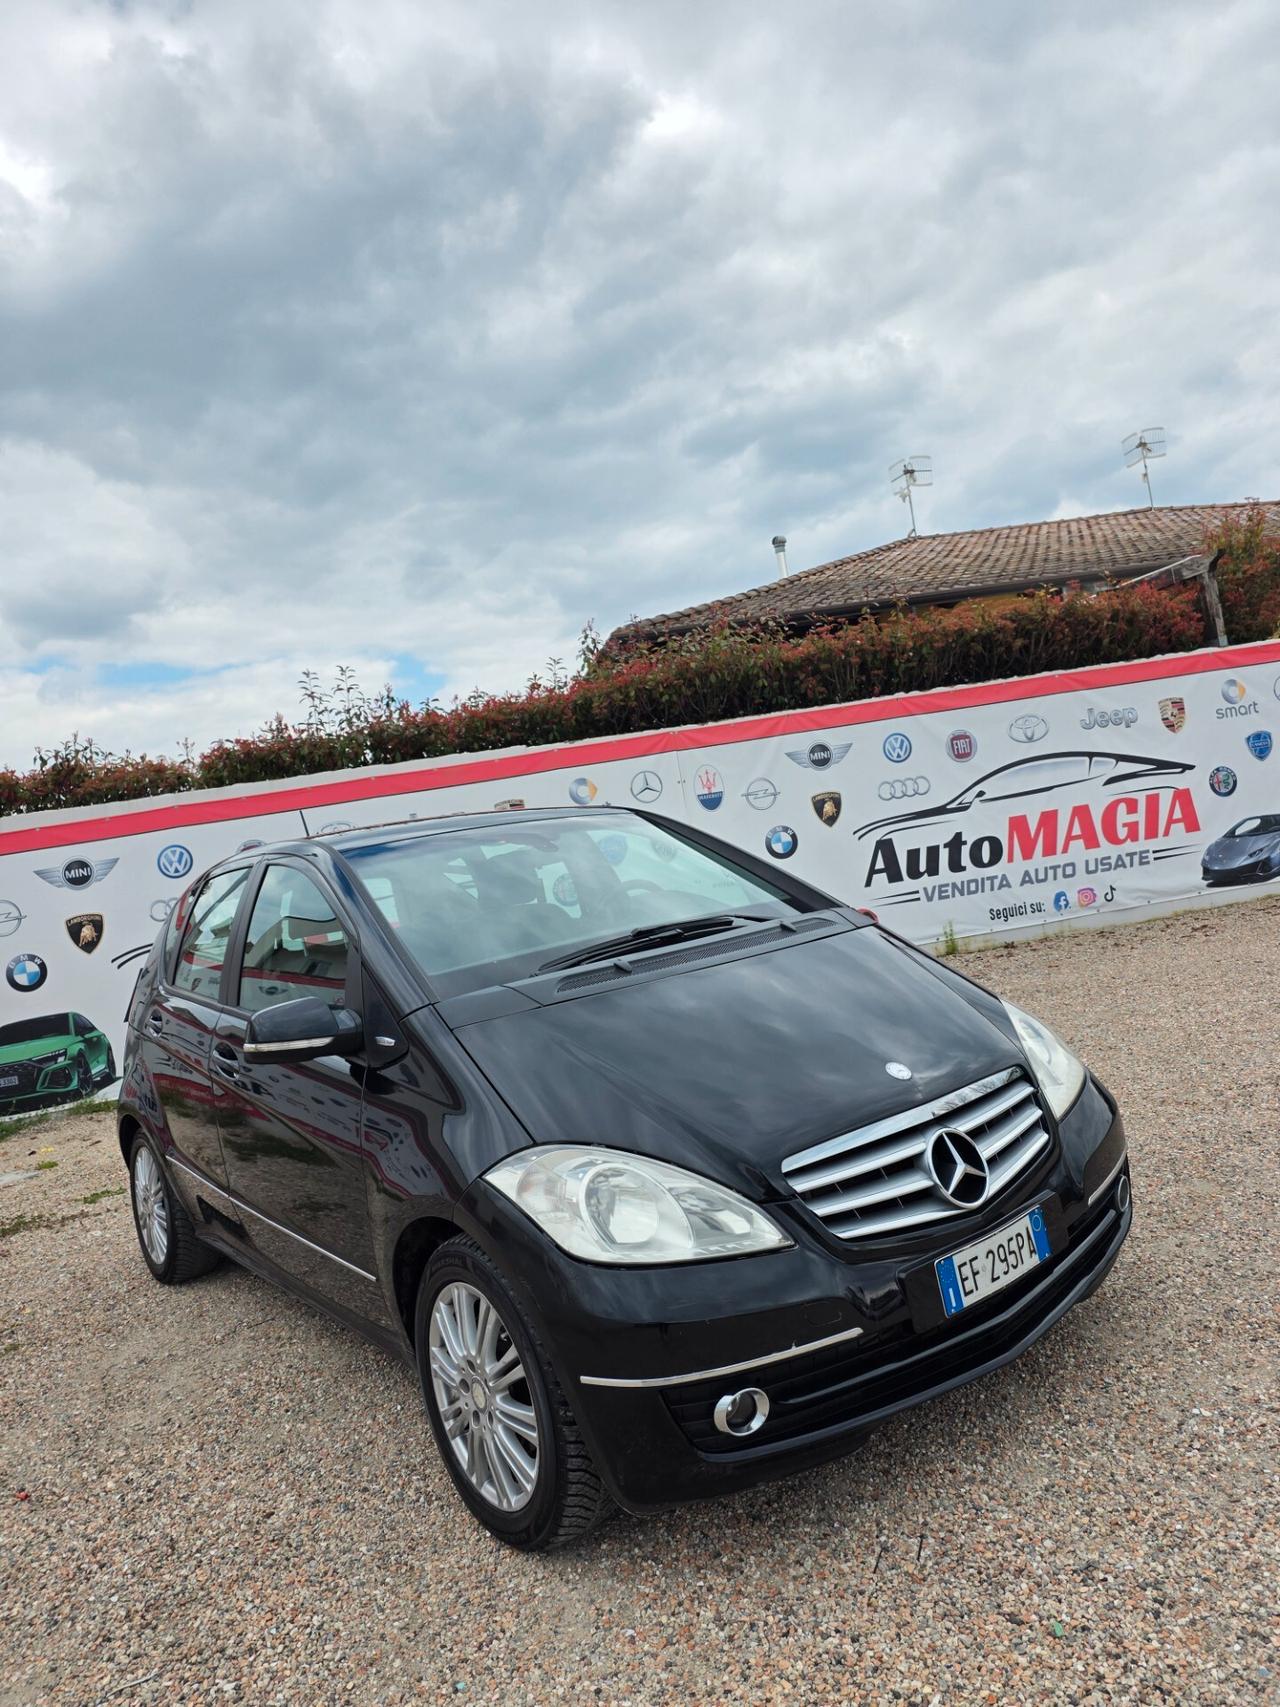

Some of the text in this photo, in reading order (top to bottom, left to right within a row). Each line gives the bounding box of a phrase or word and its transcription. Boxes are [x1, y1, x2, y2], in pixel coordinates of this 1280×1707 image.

[1080, 707, 1138, 731] Jeep
[1215, 701, 1259, 720] smart
[809, 750, 831, 761] MINI
[885, 735, 910, 761] VW
[953, 738, 970, 755] FIAT
[864, 788, 1200, 887] AutoMAGIA
[160, 847, 191, 875] VW
[64, 866, 92, 880] MINI
[922, 850, 1150, 902] VENDITA AUTO USATE
[989, 900, 1046, 921] Seguici su:
[9, 955, 42, 968] BMW
[958, 1226, 1038, 1298] EF 295PA
